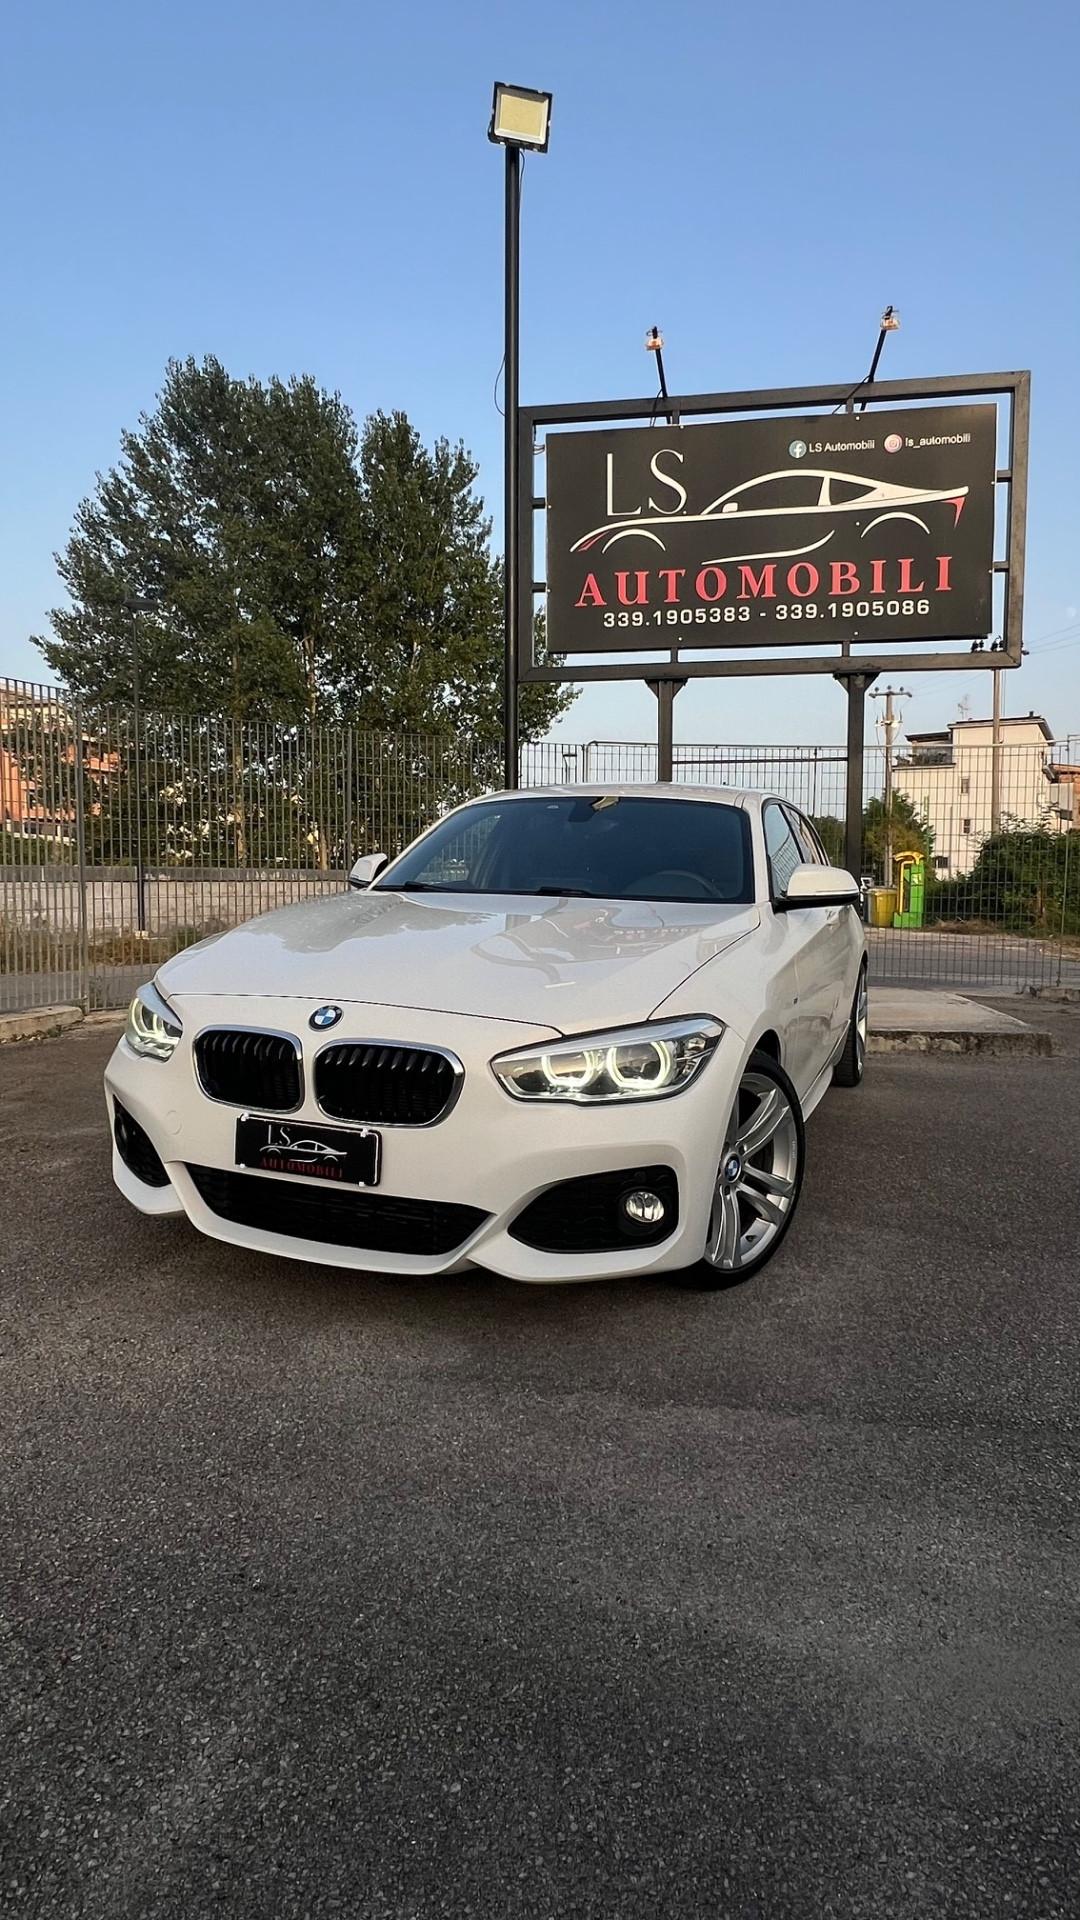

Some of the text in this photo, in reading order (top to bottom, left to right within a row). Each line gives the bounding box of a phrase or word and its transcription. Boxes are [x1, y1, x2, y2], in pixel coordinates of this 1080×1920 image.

[809, 440, 876, 453] LS Automobili
[905, 433, 971, 449] ls_automobili
[606, 448, 688, 517] LS
[575, 555, 953, 608] AUTOMOBILI
[603, 606, 750, 628] 339.1905383
[775, 599, 930, 620] 339.1905086
